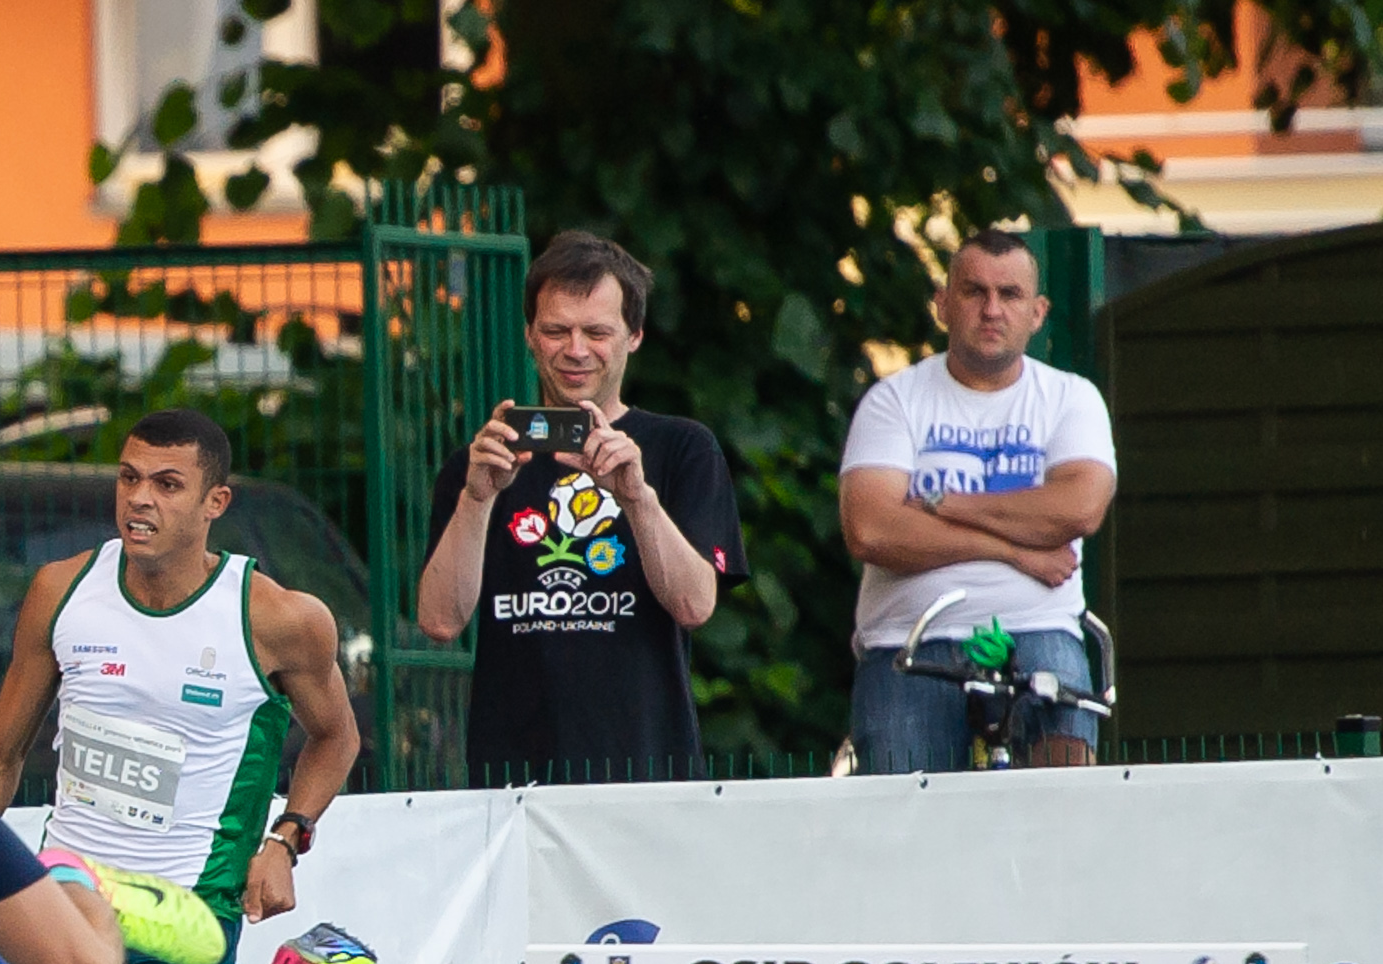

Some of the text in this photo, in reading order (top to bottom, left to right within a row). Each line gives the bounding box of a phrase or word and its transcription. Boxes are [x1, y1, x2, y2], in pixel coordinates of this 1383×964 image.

[541, 572, 582, 587] UEFA
[100, 662, 127, 677] 3M
[72, 741, 161, 792] TELES
